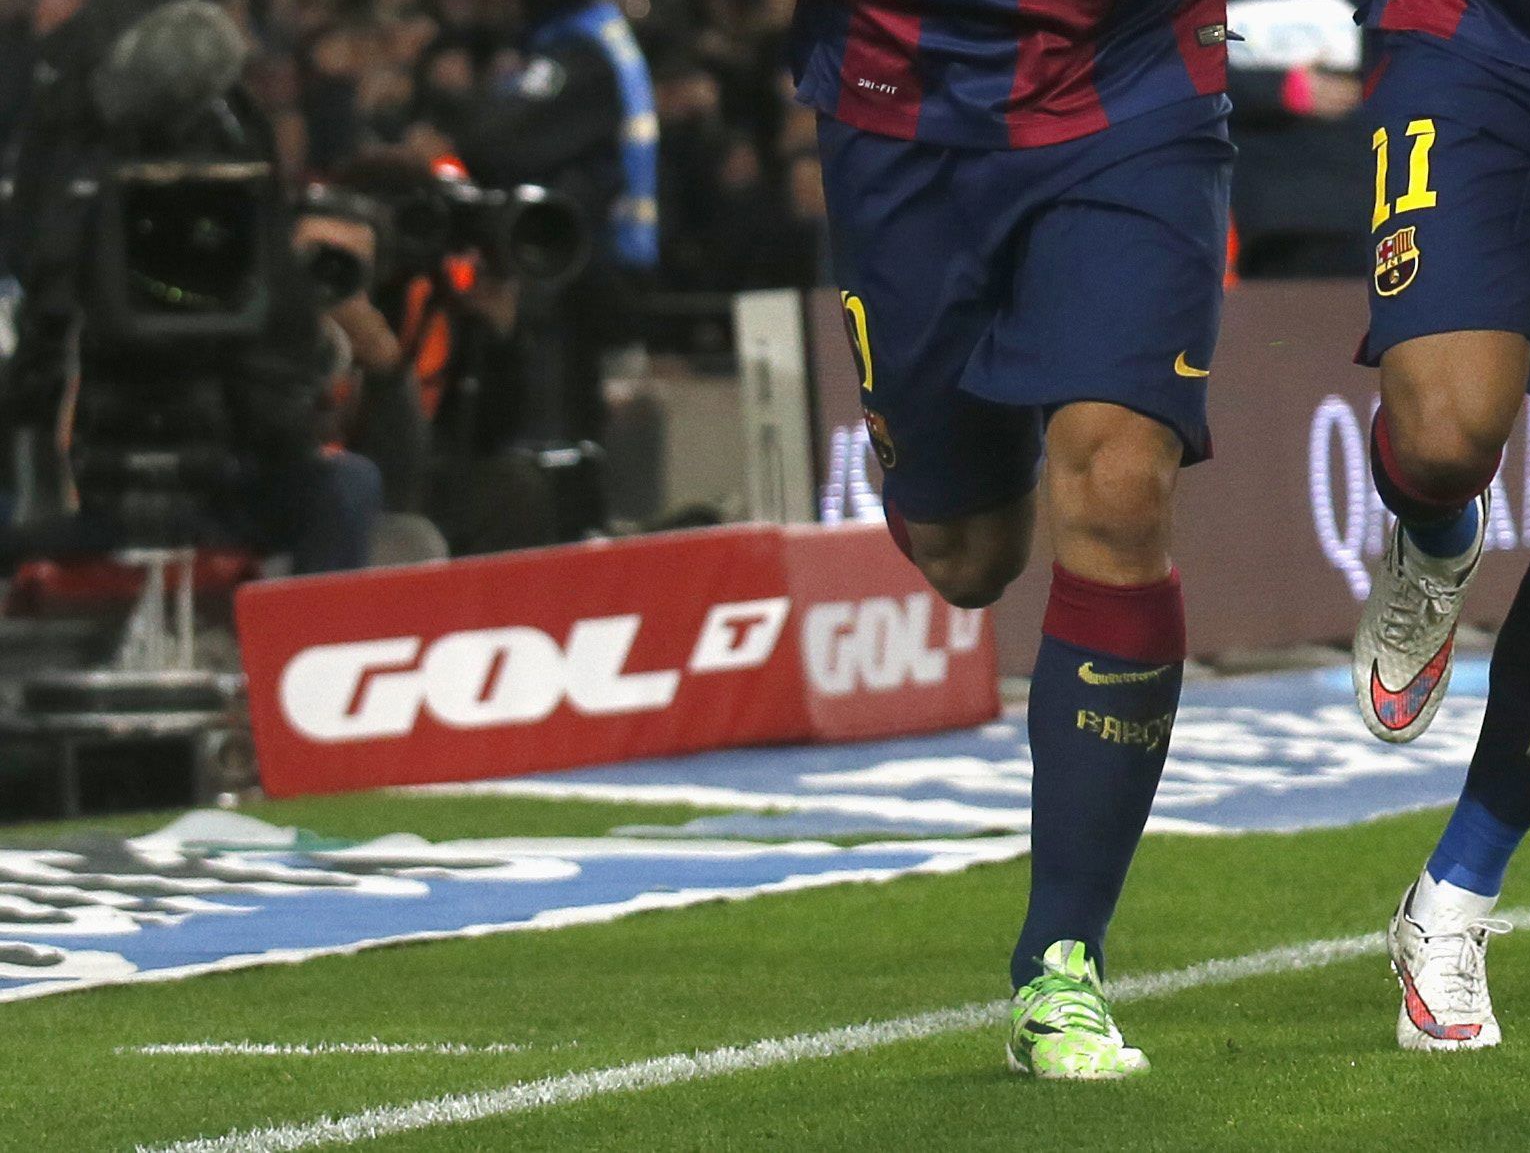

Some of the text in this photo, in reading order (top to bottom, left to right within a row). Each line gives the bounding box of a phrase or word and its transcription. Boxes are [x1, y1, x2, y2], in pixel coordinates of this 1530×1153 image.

[1371, 118, 1437, 234] 11
[279, 612, 683, 744] GOL
[803, 591, 947, 696] GOL
